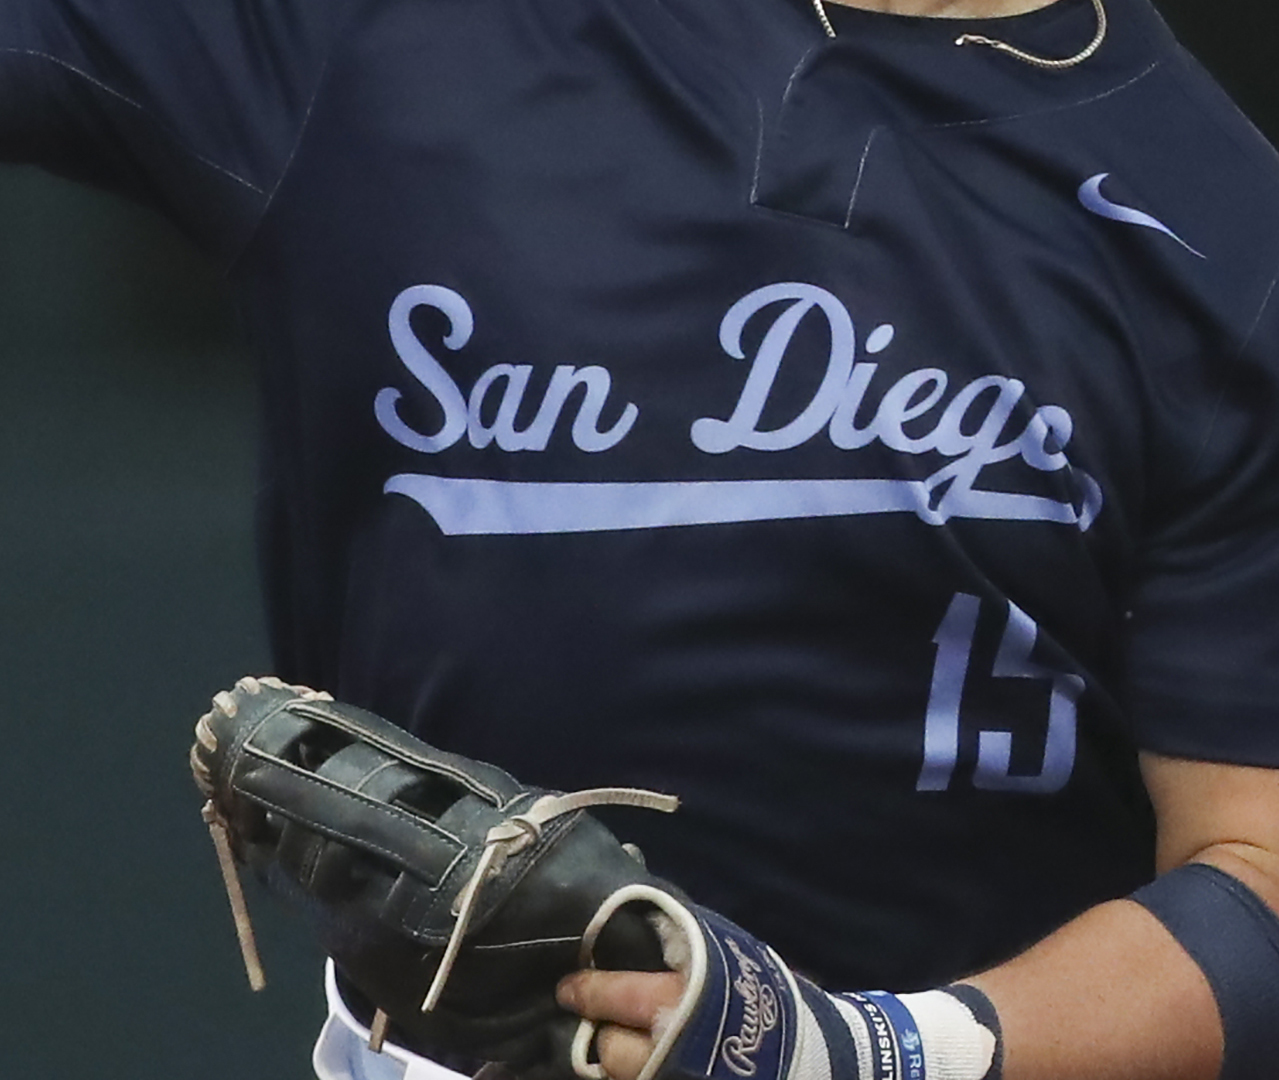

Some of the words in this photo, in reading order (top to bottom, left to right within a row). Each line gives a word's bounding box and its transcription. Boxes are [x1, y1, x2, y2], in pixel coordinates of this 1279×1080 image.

[373, 283, 639, 453] San
[690, 281, 1073, 526] Diego
[916, 592, 1086, 794] 15
